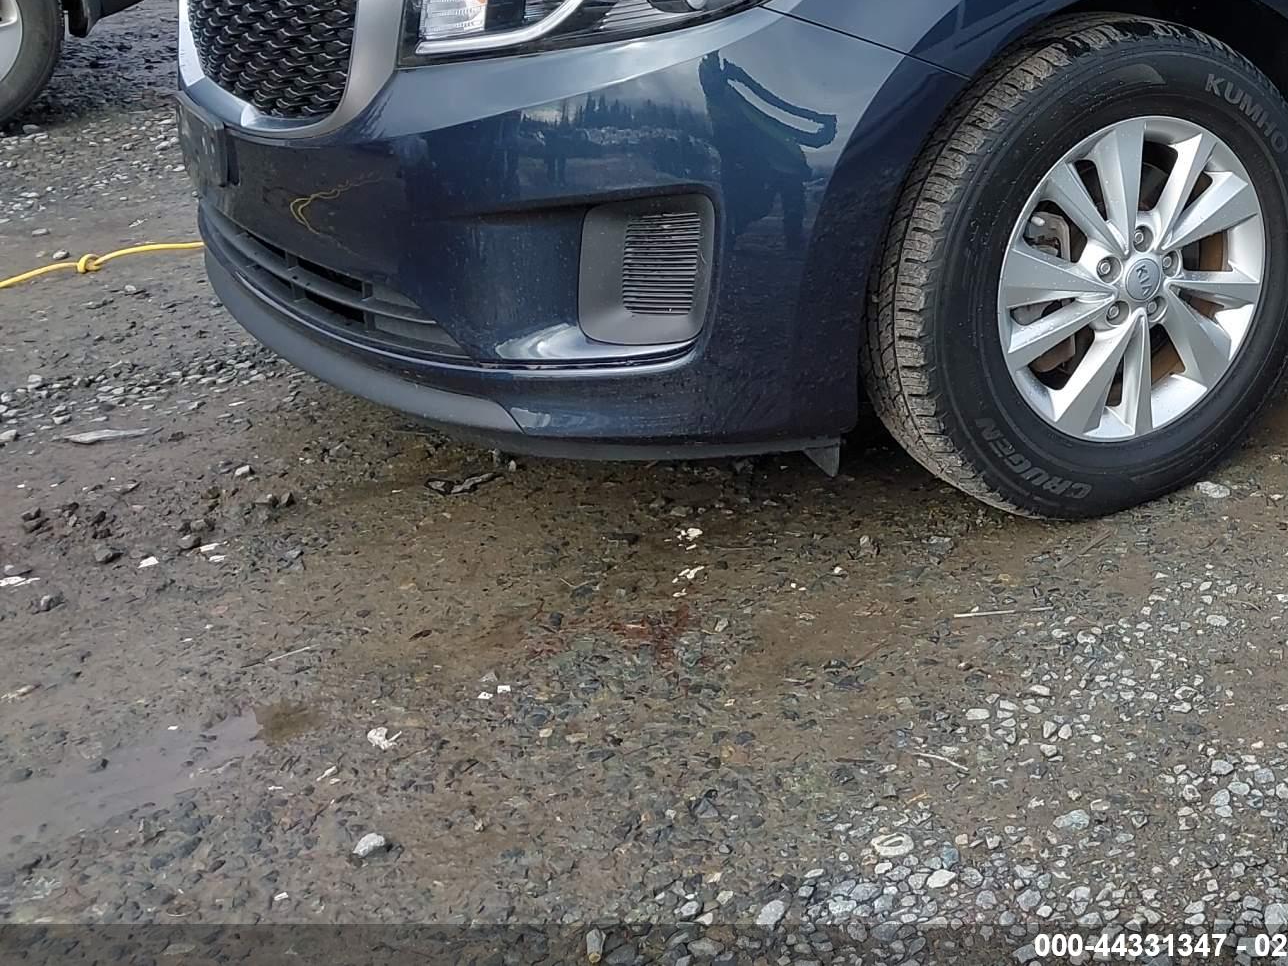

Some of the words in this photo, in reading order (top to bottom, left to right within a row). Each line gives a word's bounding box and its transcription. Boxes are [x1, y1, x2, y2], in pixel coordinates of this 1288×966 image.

[1205, 73, 1288, 154] KUMHO
[1136, 263, 1152, 296] KIA
[975, 418, 1093, 499] CRUGEN
